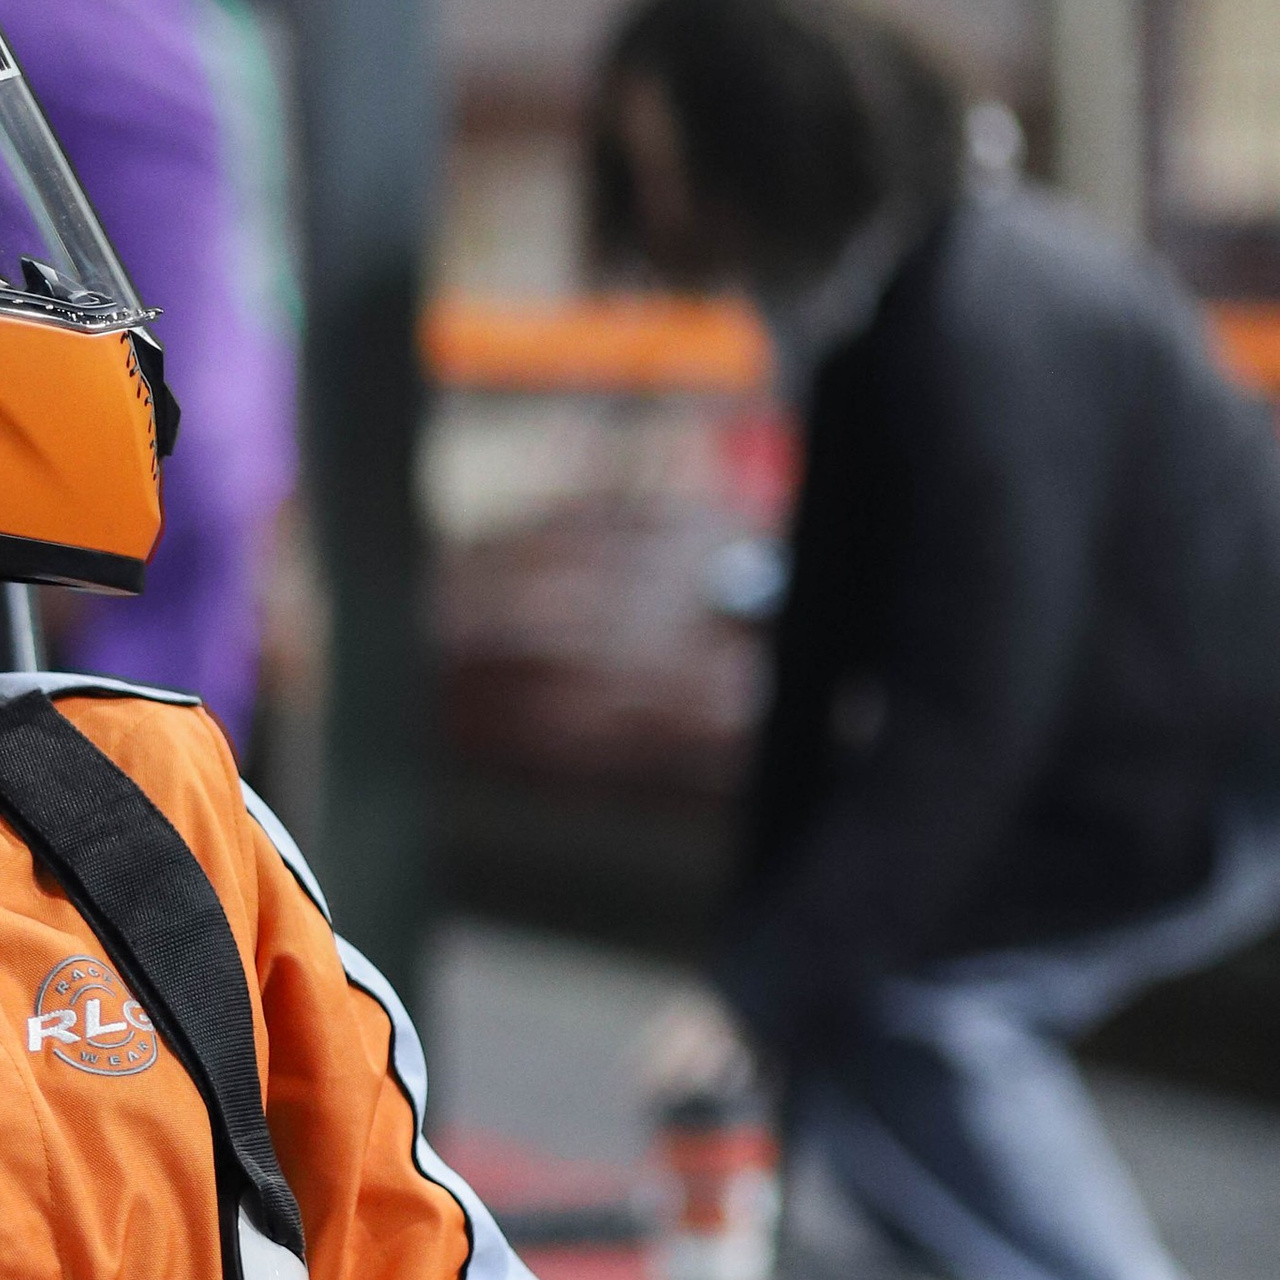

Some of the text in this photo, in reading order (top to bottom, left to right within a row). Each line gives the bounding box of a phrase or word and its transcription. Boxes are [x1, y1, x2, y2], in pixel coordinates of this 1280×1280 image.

[55, 967, 113, 995] RACE
[27, 998, 156, 1052] RLG
[80, 1039, 149, 1066] WEAR
